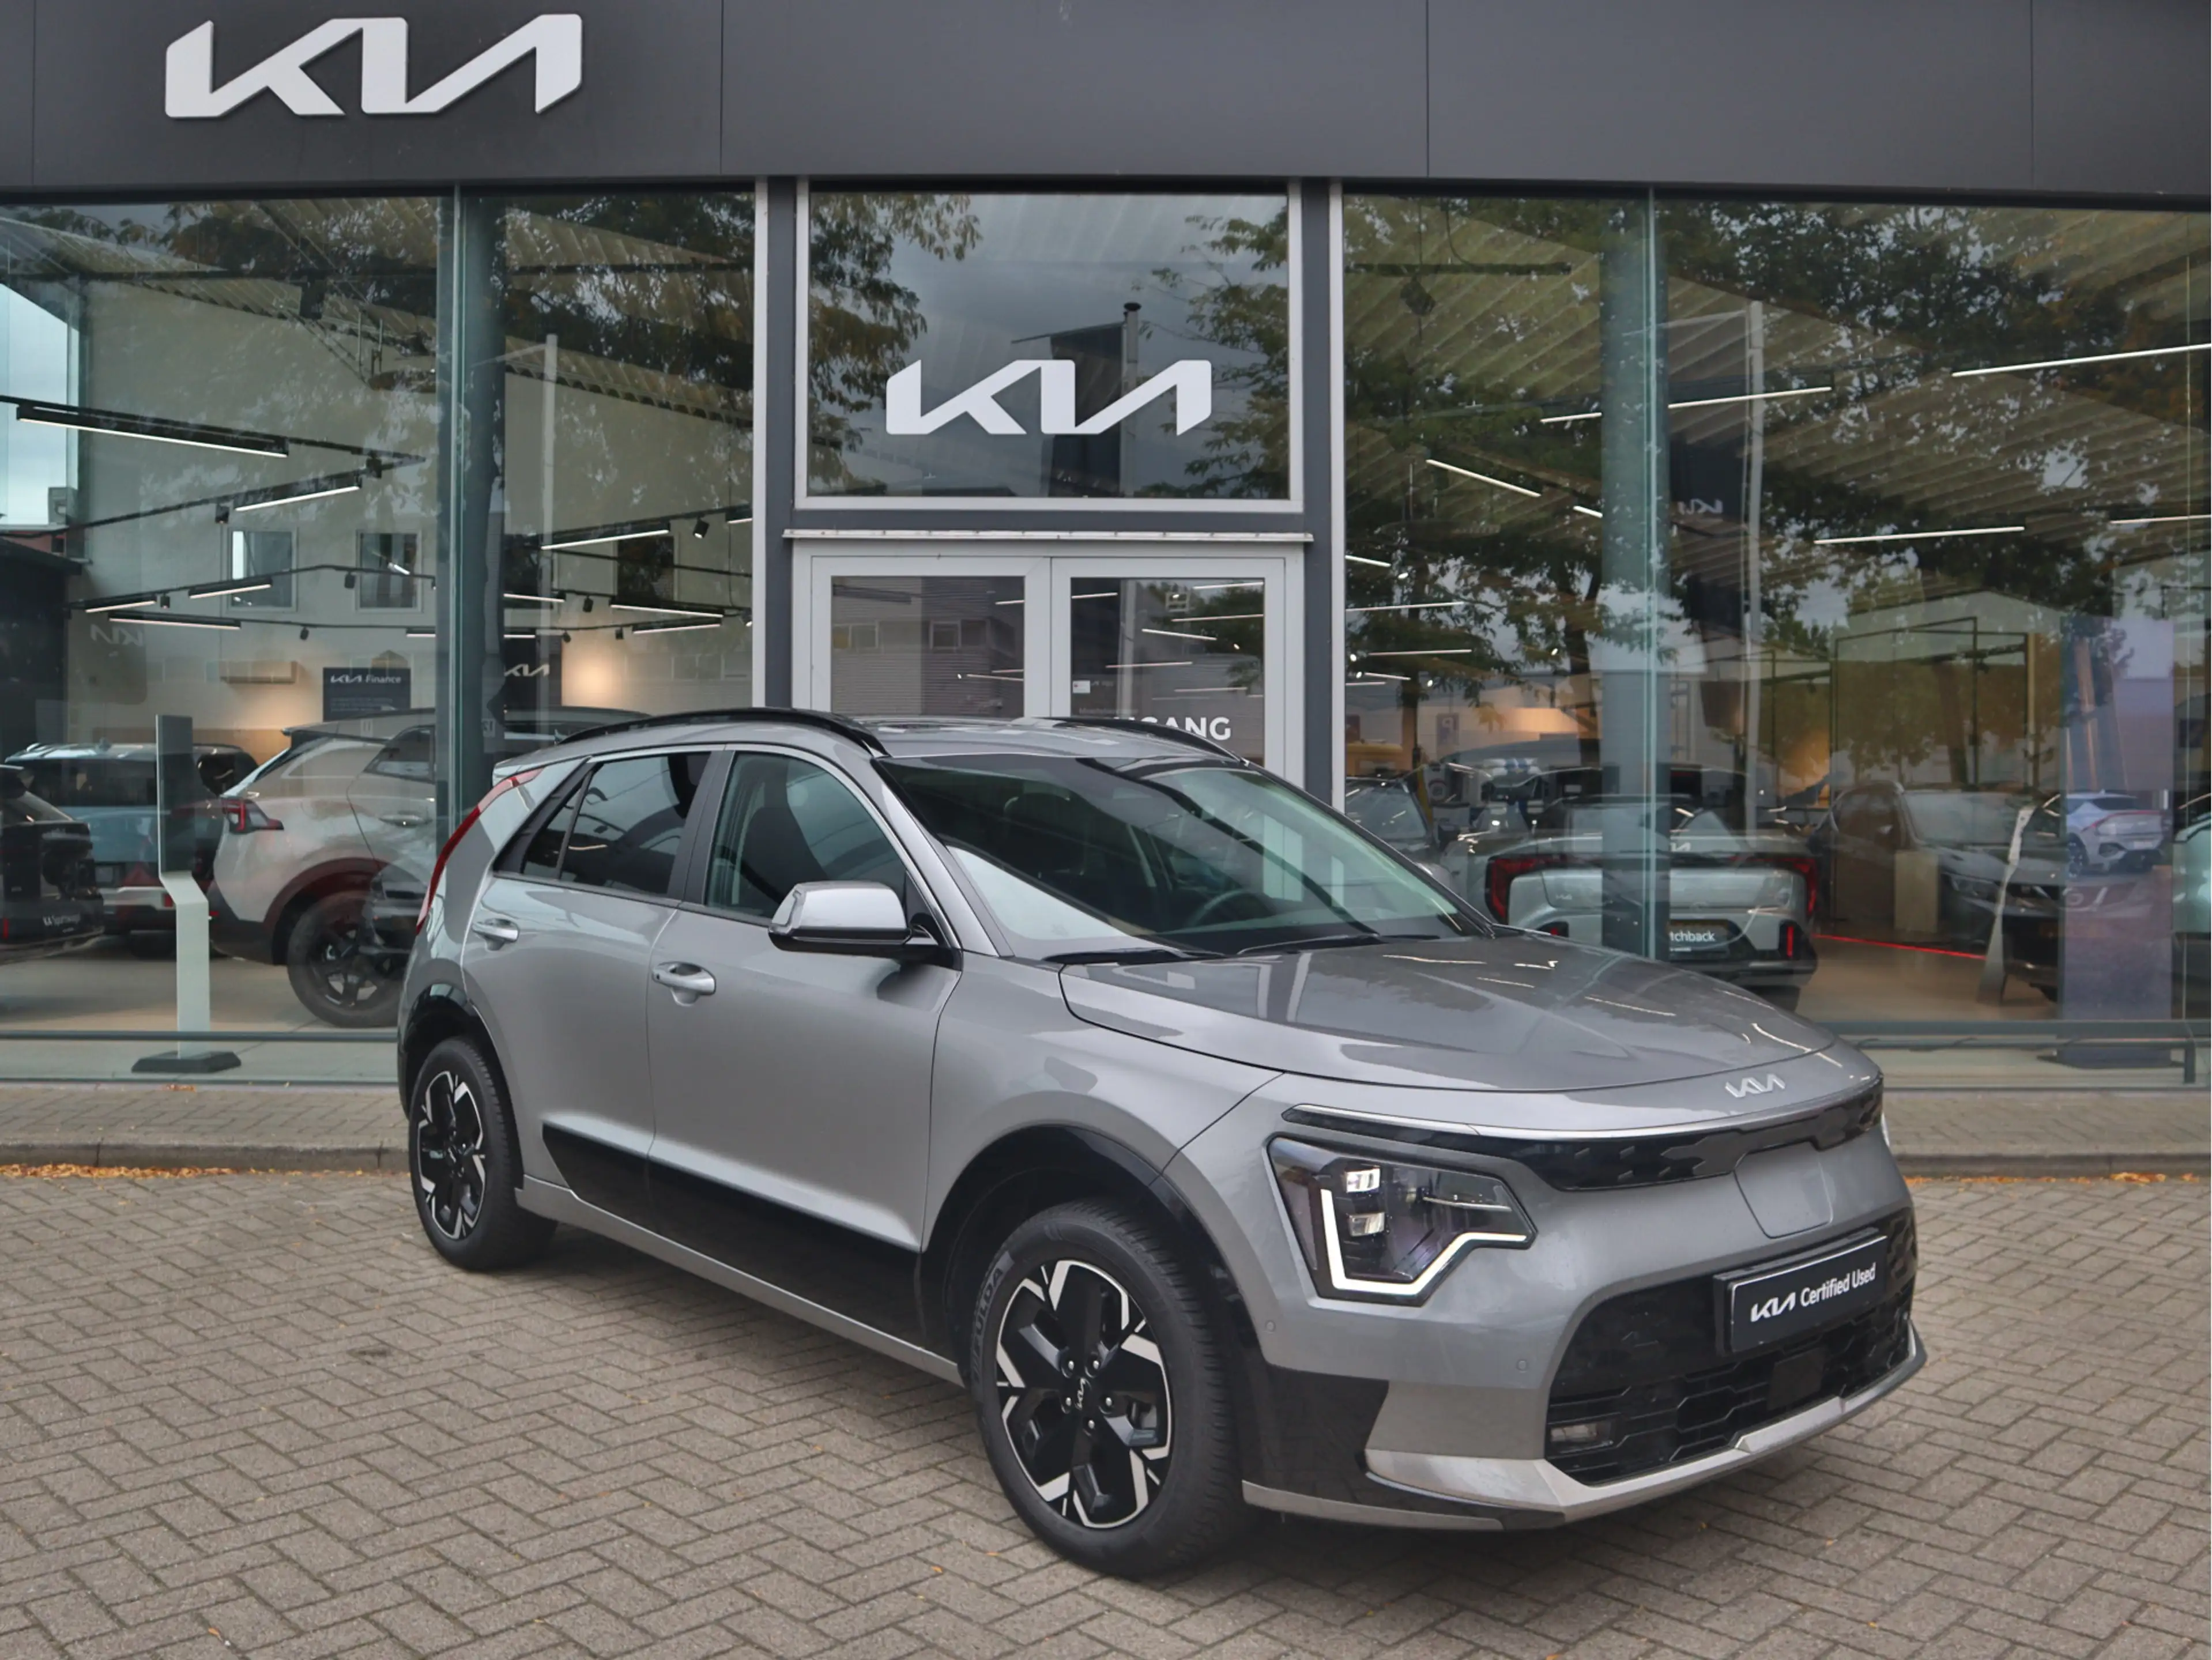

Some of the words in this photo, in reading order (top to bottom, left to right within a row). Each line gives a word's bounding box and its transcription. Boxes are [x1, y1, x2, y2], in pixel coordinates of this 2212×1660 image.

[165, 14, 582, 118] KIA
[886, 359, 1211, 436] KIA
[330, 674, 362, 684] KIA
[365, 674, 402, 684] Finance
[1725, 1074, 1785, 1098] KIA
[1750, 1292, 1796, 1322] KIA
[1799, 1273, 1851, 1307] Certified
[1851, 1262, 1876, 1289] Used
